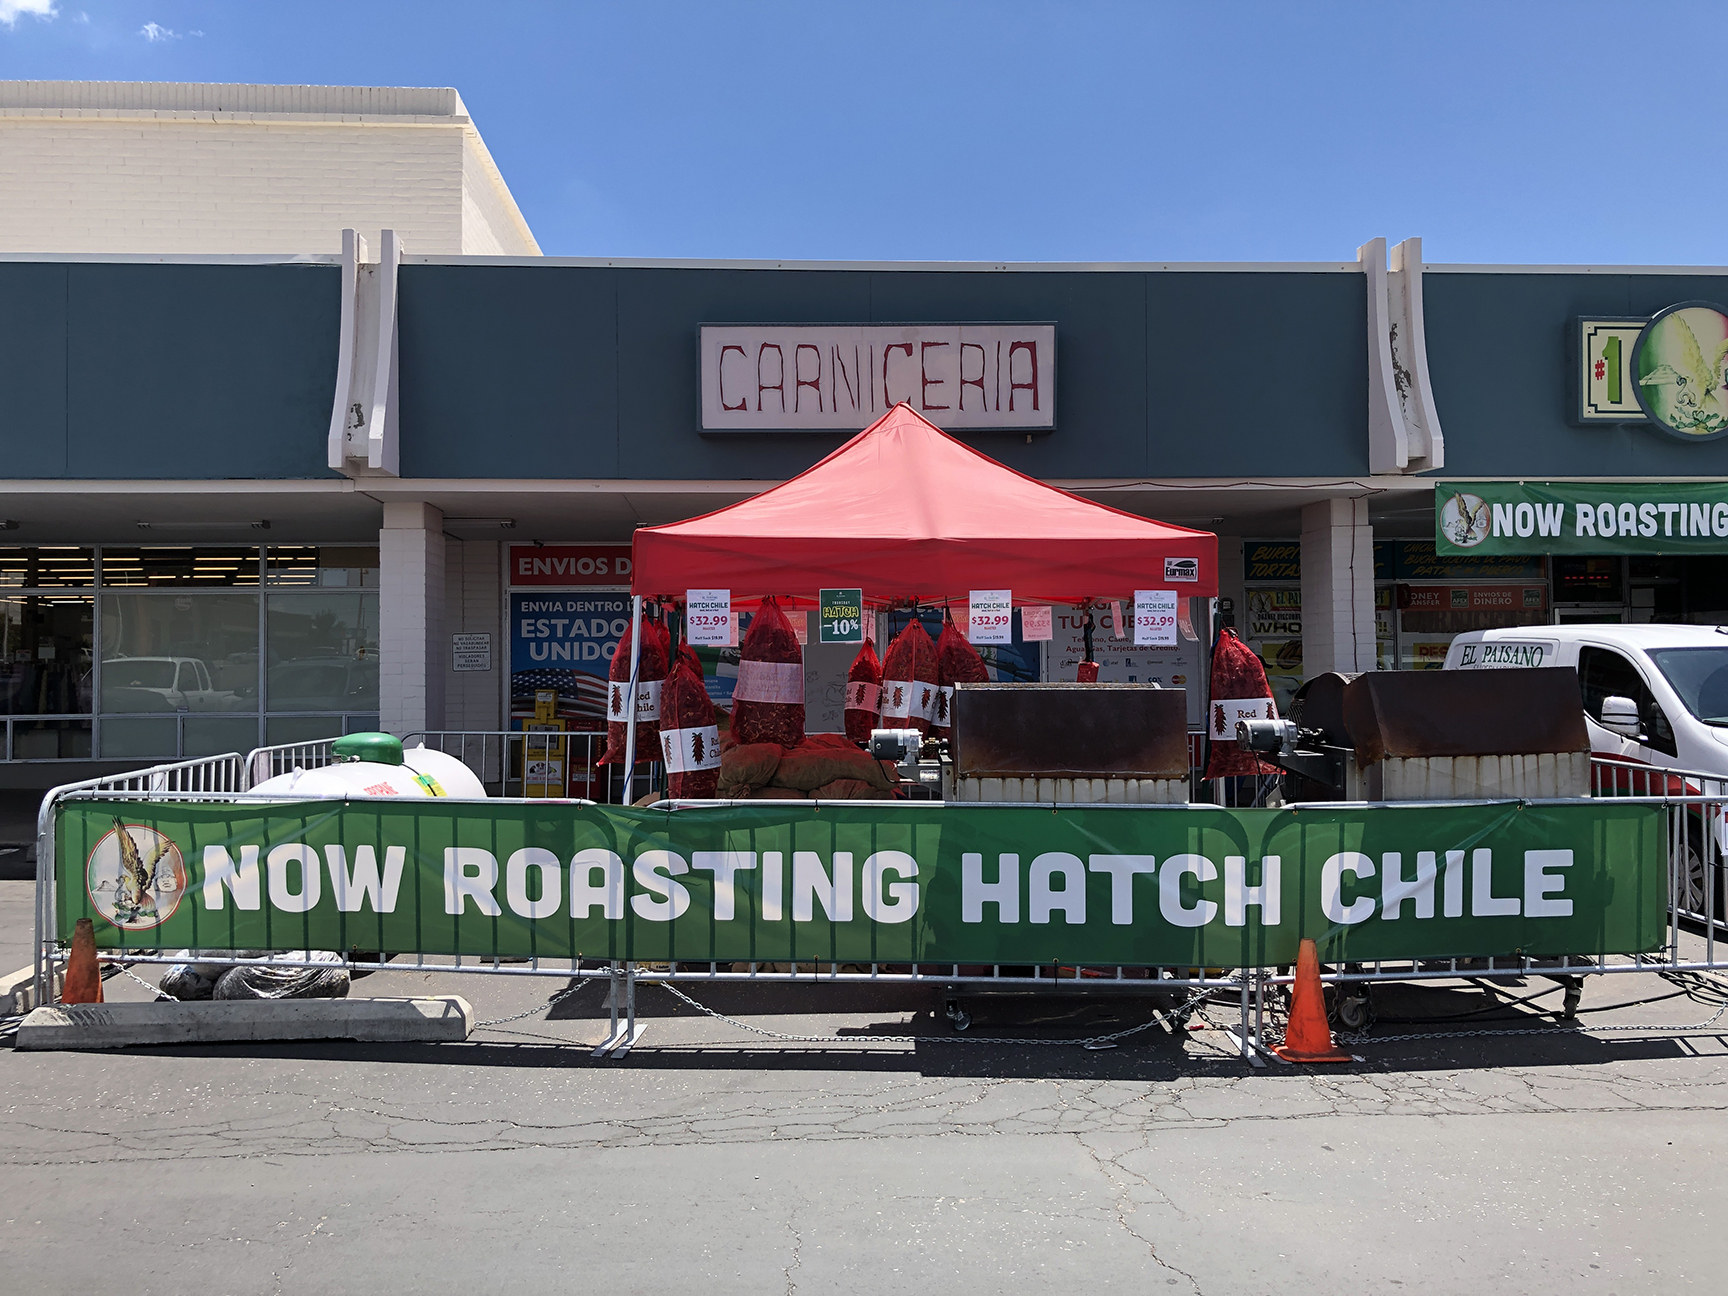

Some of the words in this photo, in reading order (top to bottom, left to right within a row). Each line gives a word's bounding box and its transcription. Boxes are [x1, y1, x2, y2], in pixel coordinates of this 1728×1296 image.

[1595, 336, 1622, 404] #1
[719, 340, 1040, 413] CARNICERIA
[1492, 502, 1565, 538] NOW
[1575, 502, 1728, 538] ROASTING
[1251, 545, 1300, 561] BURRI
[519, 557, 608, 575] ENVIOS
[615, 557, 632, 575] D
[1165, 566, 1195, 577] Eurmax
[1412, 566, 1461, 576] PATAS
[1478, 566, 1524, 576] PUERCO
[1276, 591, 1285, 604] EL
[1411, 592, 1440, 600] ONEY
[521, 601, 563, 612] ENVIA
[566, 601, 623, 612] DENTRO
[823, 606, 859, 618] HATCH
[690, 616, 728, 626] $32.99
[971, 615, 1009, 626] $32.99
[1058, 616, 1084, 629] TU
[1137, 616, 1174, 626] $32.99
[521, 618, 630, 638] ESTADO
[823, 619, 859, 635] -10%
[1252, 622, 1302, 633] WHO
[529, 641, 620, 660] UNIDO
[1107, 645, 1138, 653] Tarjetas
[1460, 645, 1477, 667] EL
[1481, 645, 1544, 668] PAISANO
[637, 691, 650, 700] ed
[637, 704, 655, 712] hile
[1237, 709, 1257, 719] Red
[203, 843, 407, 913] NOW
[443, 846, 920, 924] ROASTING
[961, 852, 1281, 928] HATCH
[1321, 848, 1574, 925] CHILE
